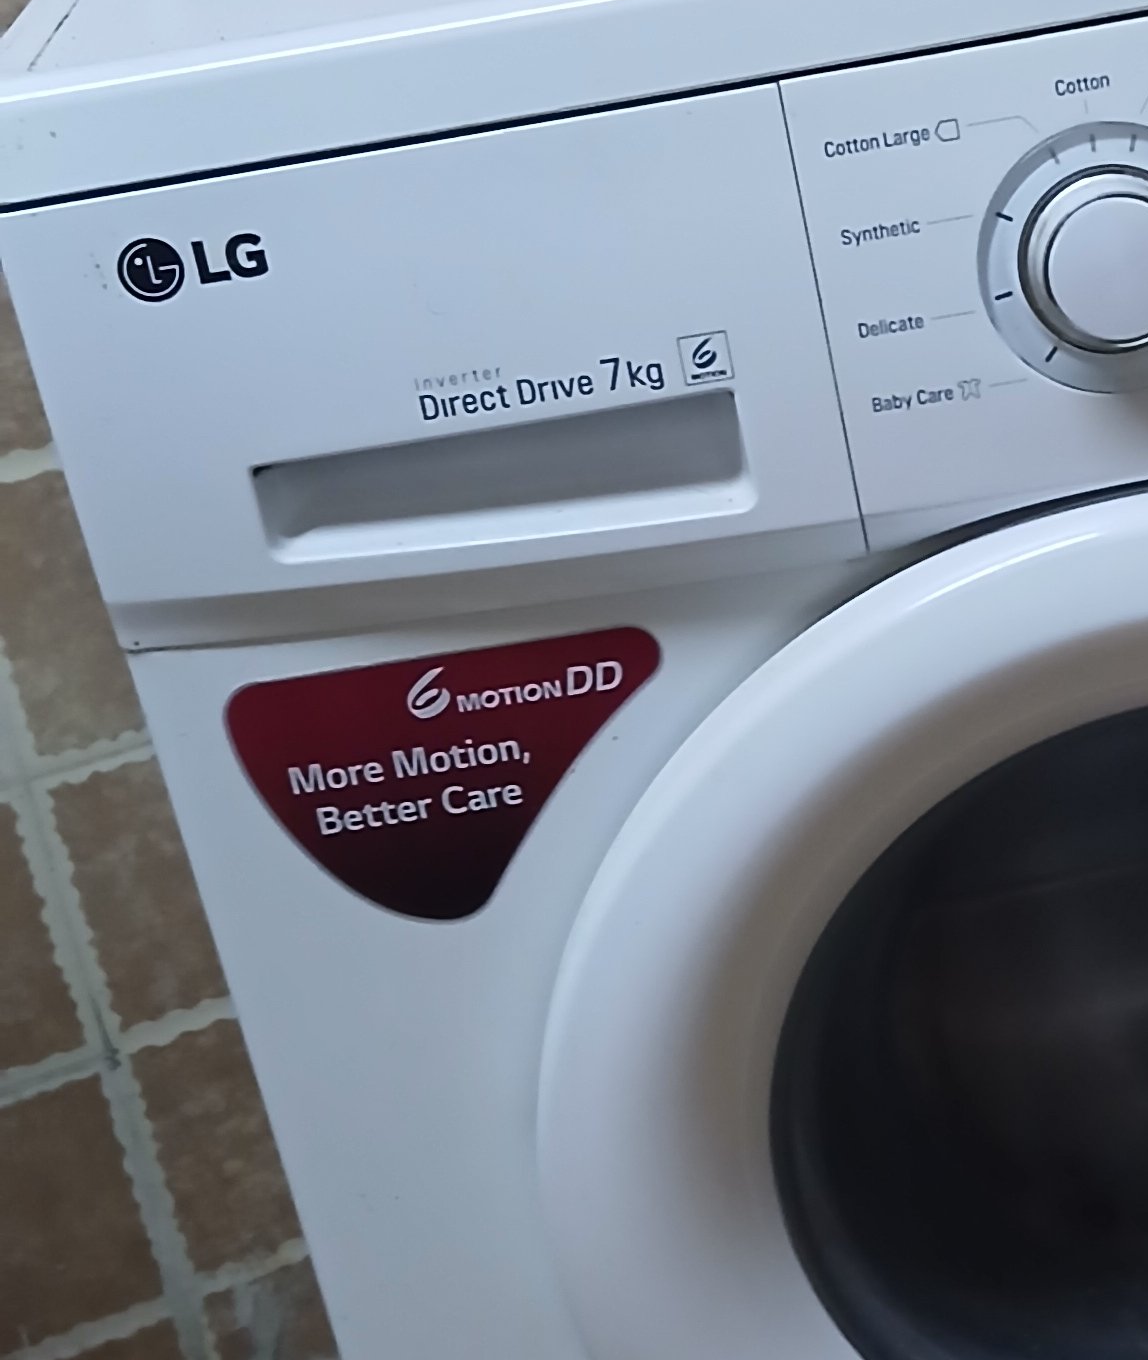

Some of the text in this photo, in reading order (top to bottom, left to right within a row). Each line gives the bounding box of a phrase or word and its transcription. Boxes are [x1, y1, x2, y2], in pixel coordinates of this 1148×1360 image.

[1054, 73, 1110, 97] Cotton
[823, 126, 931, 159] Cotton Large
[840, 219, 921, 247] Synthetic
[191, 233, 269, 284] LG
[857, 316, 925, 339] Delicate
[419, 386, 510, 421] Direct
[516, 374, 594, 406] Drive
[871, 384, 955, 418] Baby Care
[456, 680, 563, 713] MOTION
[287, 738, 532, 795] More Motion,
[315, 783, 524, 836] Better Care
